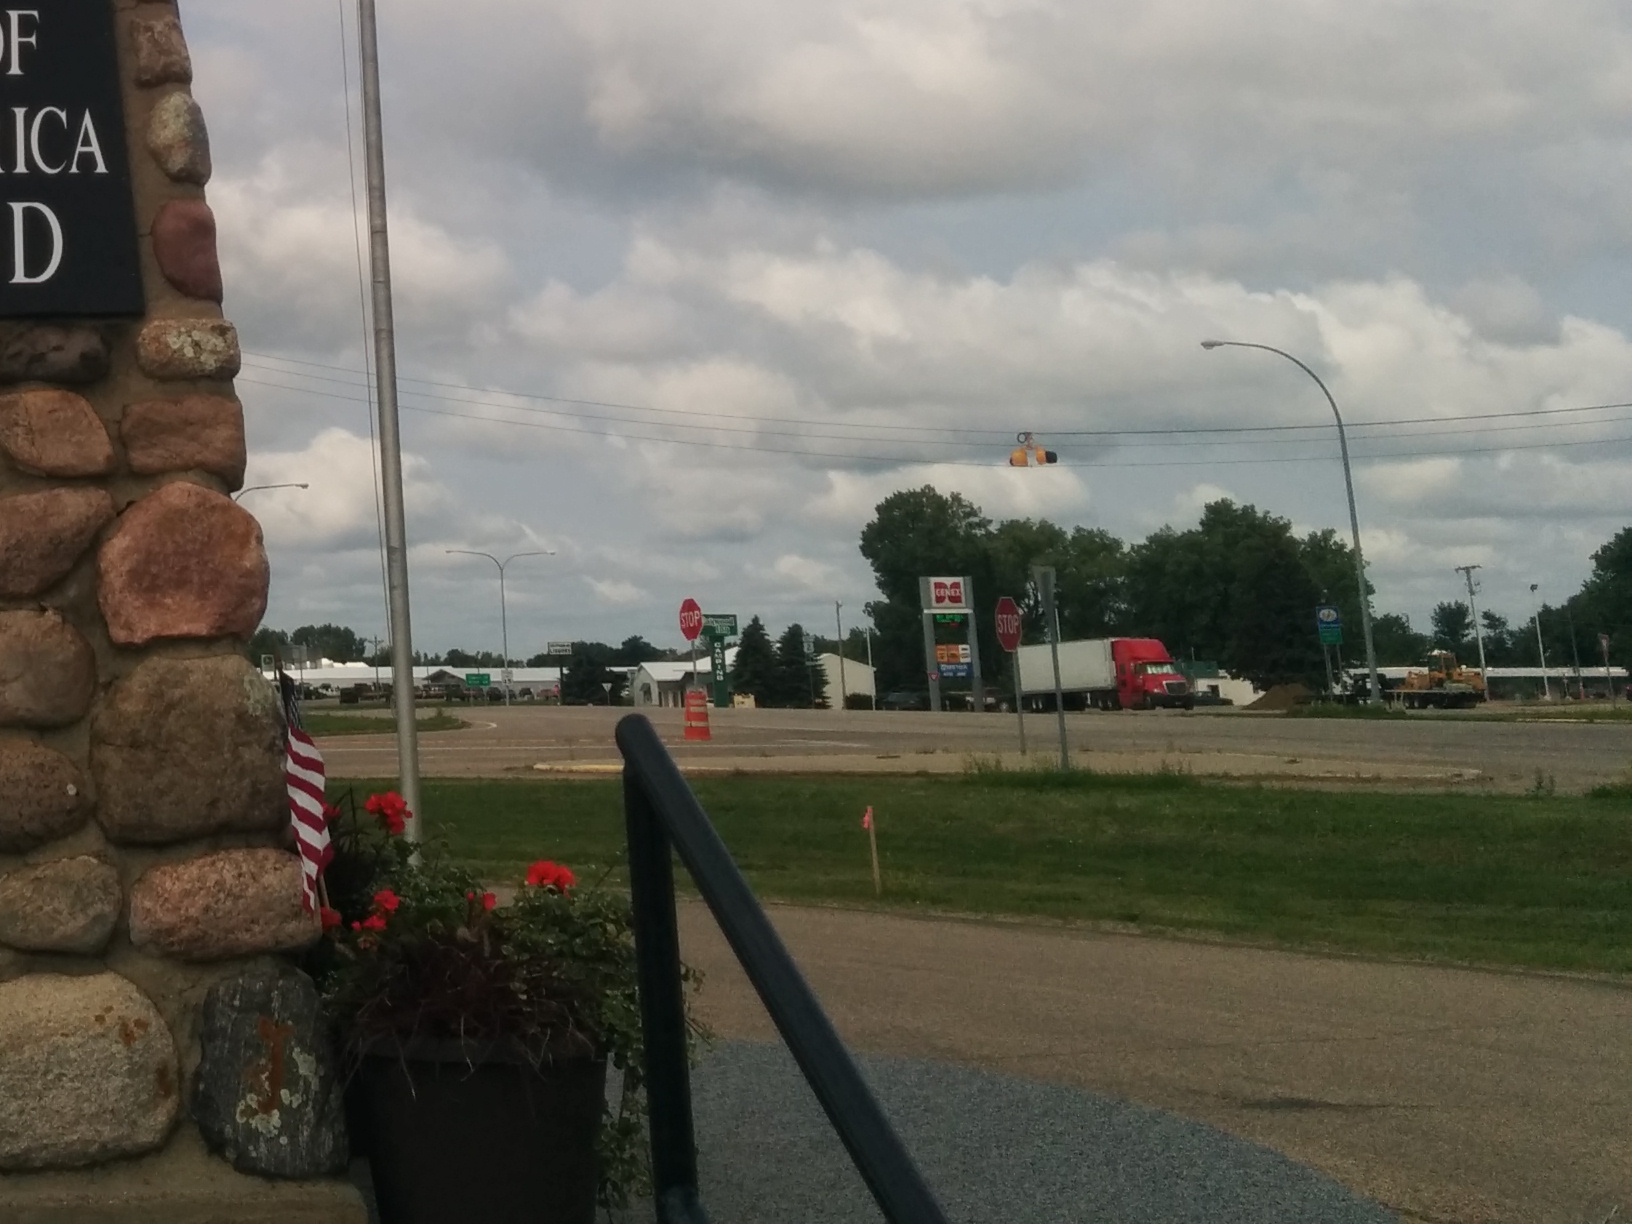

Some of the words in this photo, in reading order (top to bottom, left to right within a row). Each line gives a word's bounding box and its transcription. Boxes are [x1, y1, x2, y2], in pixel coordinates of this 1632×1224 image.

[935, 588, 961, 597] CENEX
[681, 611, 700, 628] STOP
[998, 614, 1020, 634] STOP
